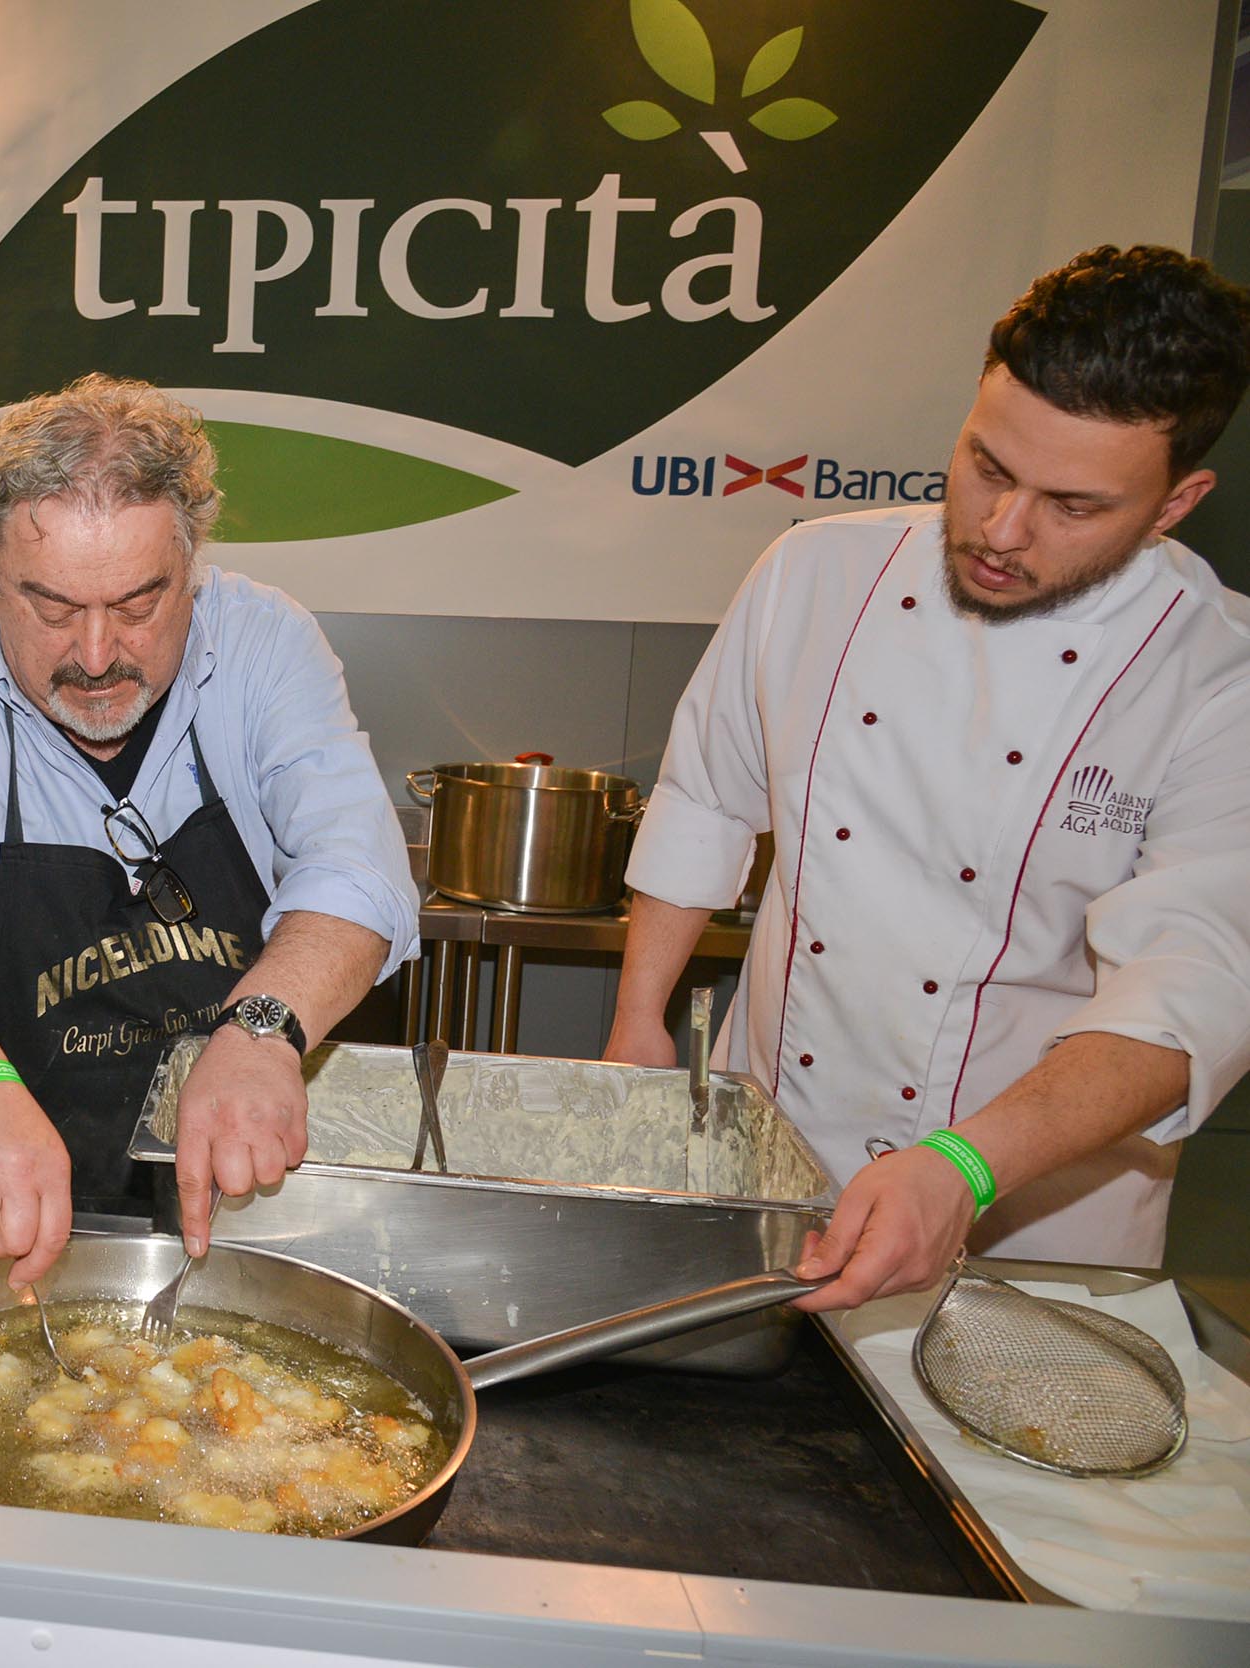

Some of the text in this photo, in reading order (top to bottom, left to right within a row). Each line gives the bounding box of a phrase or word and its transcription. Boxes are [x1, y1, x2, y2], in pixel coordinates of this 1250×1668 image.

[632, 455, 948, 502] UBI Banca
[1059, 813, 1097, 836] AGA
[63, 1024, 114, 1057] Carpi
